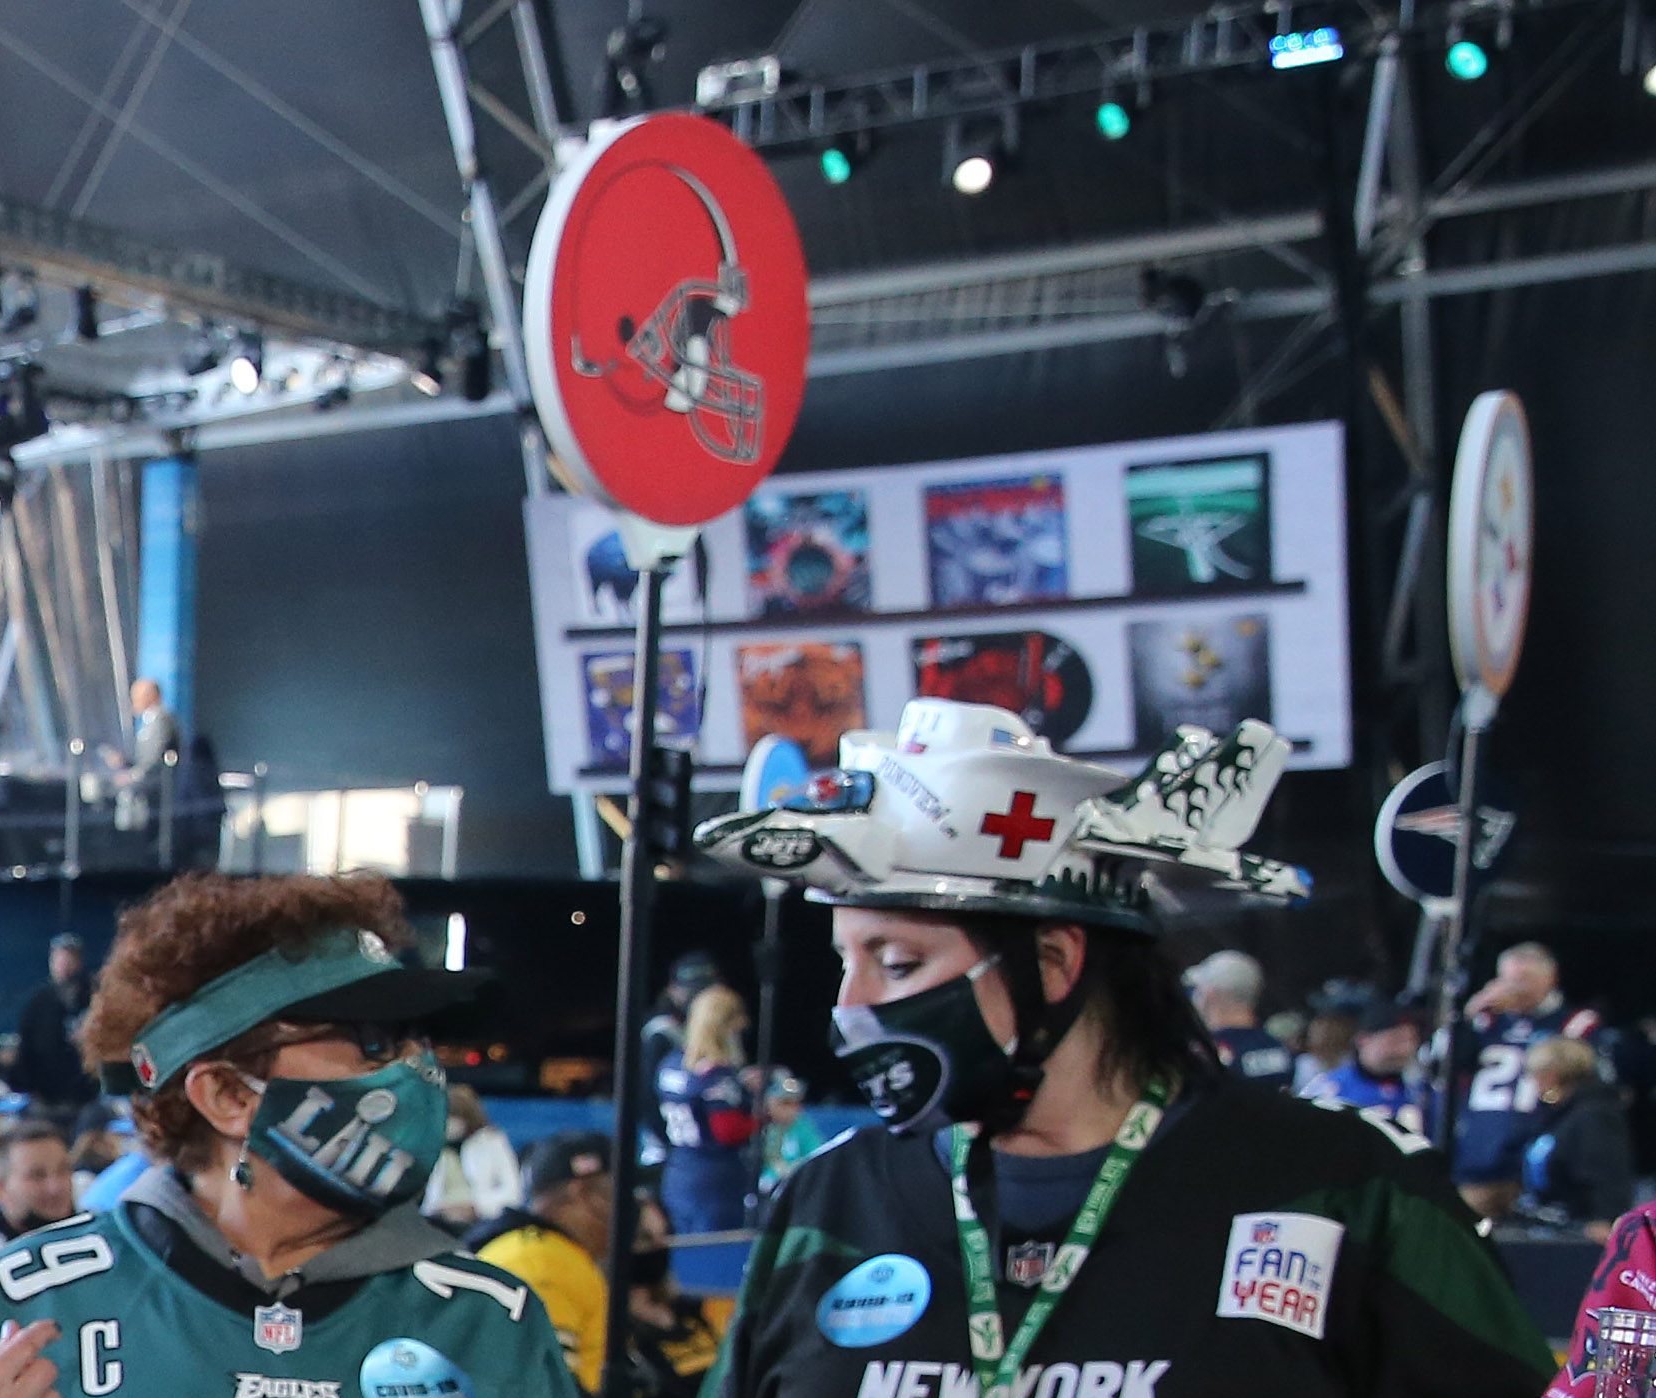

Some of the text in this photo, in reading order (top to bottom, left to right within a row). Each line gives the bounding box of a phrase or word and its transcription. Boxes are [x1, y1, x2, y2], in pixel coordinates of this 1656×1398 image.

[1236, 1248, 1307, 1285] FAN
[1233, 1280, 1318, 1329] YEAR
[261, 1320, 297, 1345] NFL
[80, 1318, 123, 1397] C
